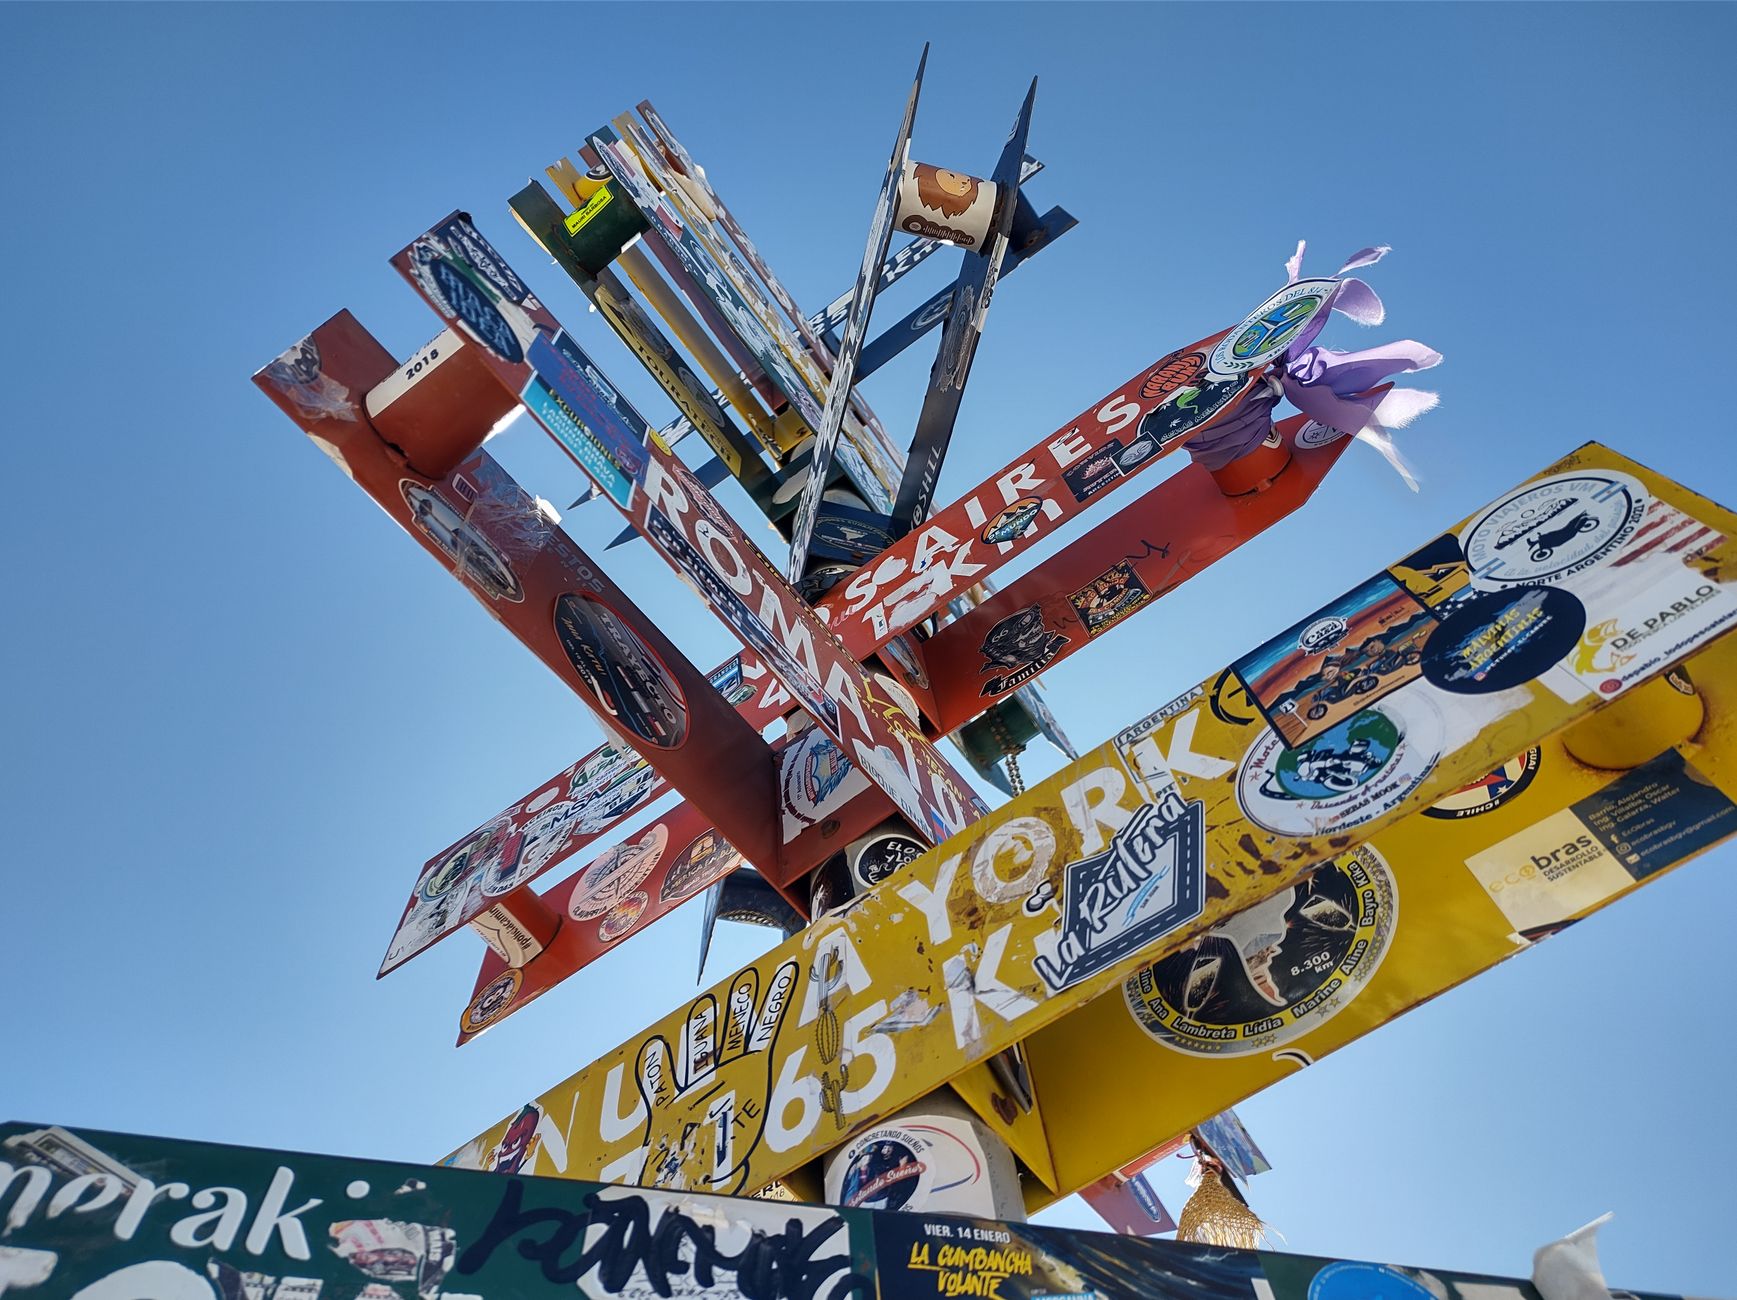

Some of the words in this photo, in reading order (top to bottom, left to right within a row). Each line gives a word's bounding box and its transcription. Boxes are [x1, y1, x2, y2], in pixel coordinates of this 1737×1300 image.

[405, 348, 440, 381] 2018
[911, 396, 1142, 574] AIRES
[1472, 527, 1491, 562] MOTO
[1489, 482, 1564, 526] VIAJEROS
[1568, 482, 1598, 494] VM
[1566, 526, 1635, 577] ARGENTINO
[1629, 503, 1646, 526] 2021
[651, 519, 683, 553] POR
[683, 555, 746, 619] SIEMPRE
[644, 455, 874, 744] ROMA
[1610, 628, 1643, 650] DE
[1642, 584, 1715, 631] PABLO
[591, 614, 688, 725] TRAYECTO
[1125, 690, 1200, 742] ARGENTINA
[549, 789, 607, 831] MSA
[898, 708, 1236, 946] YORK
[1456, 801, 1494, 818] CHILE
[1348, 861, 1371, 887] Kika
[1543, 844, 1600, 878] DESARROLLO
[1548, 850, 1606, 883] SUSTENTABLE
[1360, 890, 1378, 928] Bayro
[1037, 926, 1088, 990] La
[1290, 951, 1331, 977] 8.300
[1314, 959, 1335, 975] km
[1340, 938, 1368, 976] Aline
[756, 974, 793, 1043] NEGRO
[1149, 998, 1169, 1021] Ana
[1291, 978, 1341, 1018] Marine
[692, 1008, 711, 1076] IGUANA
[1171, 1016, 1237, 1041] Lambreta
[1243, 1016, 1284, 1037] Lídia
[924, 1222, 955, 1239] VIER.
[957, 1226, 972, 1240] 14
[973, 1227, 1011, 1245] ENERO
[907, 1241, 931, 1267] LA
[937, 1245, 1034, 1279] CUMBANCHA
[937, 1268, 1008, 1300] VOLANTE
